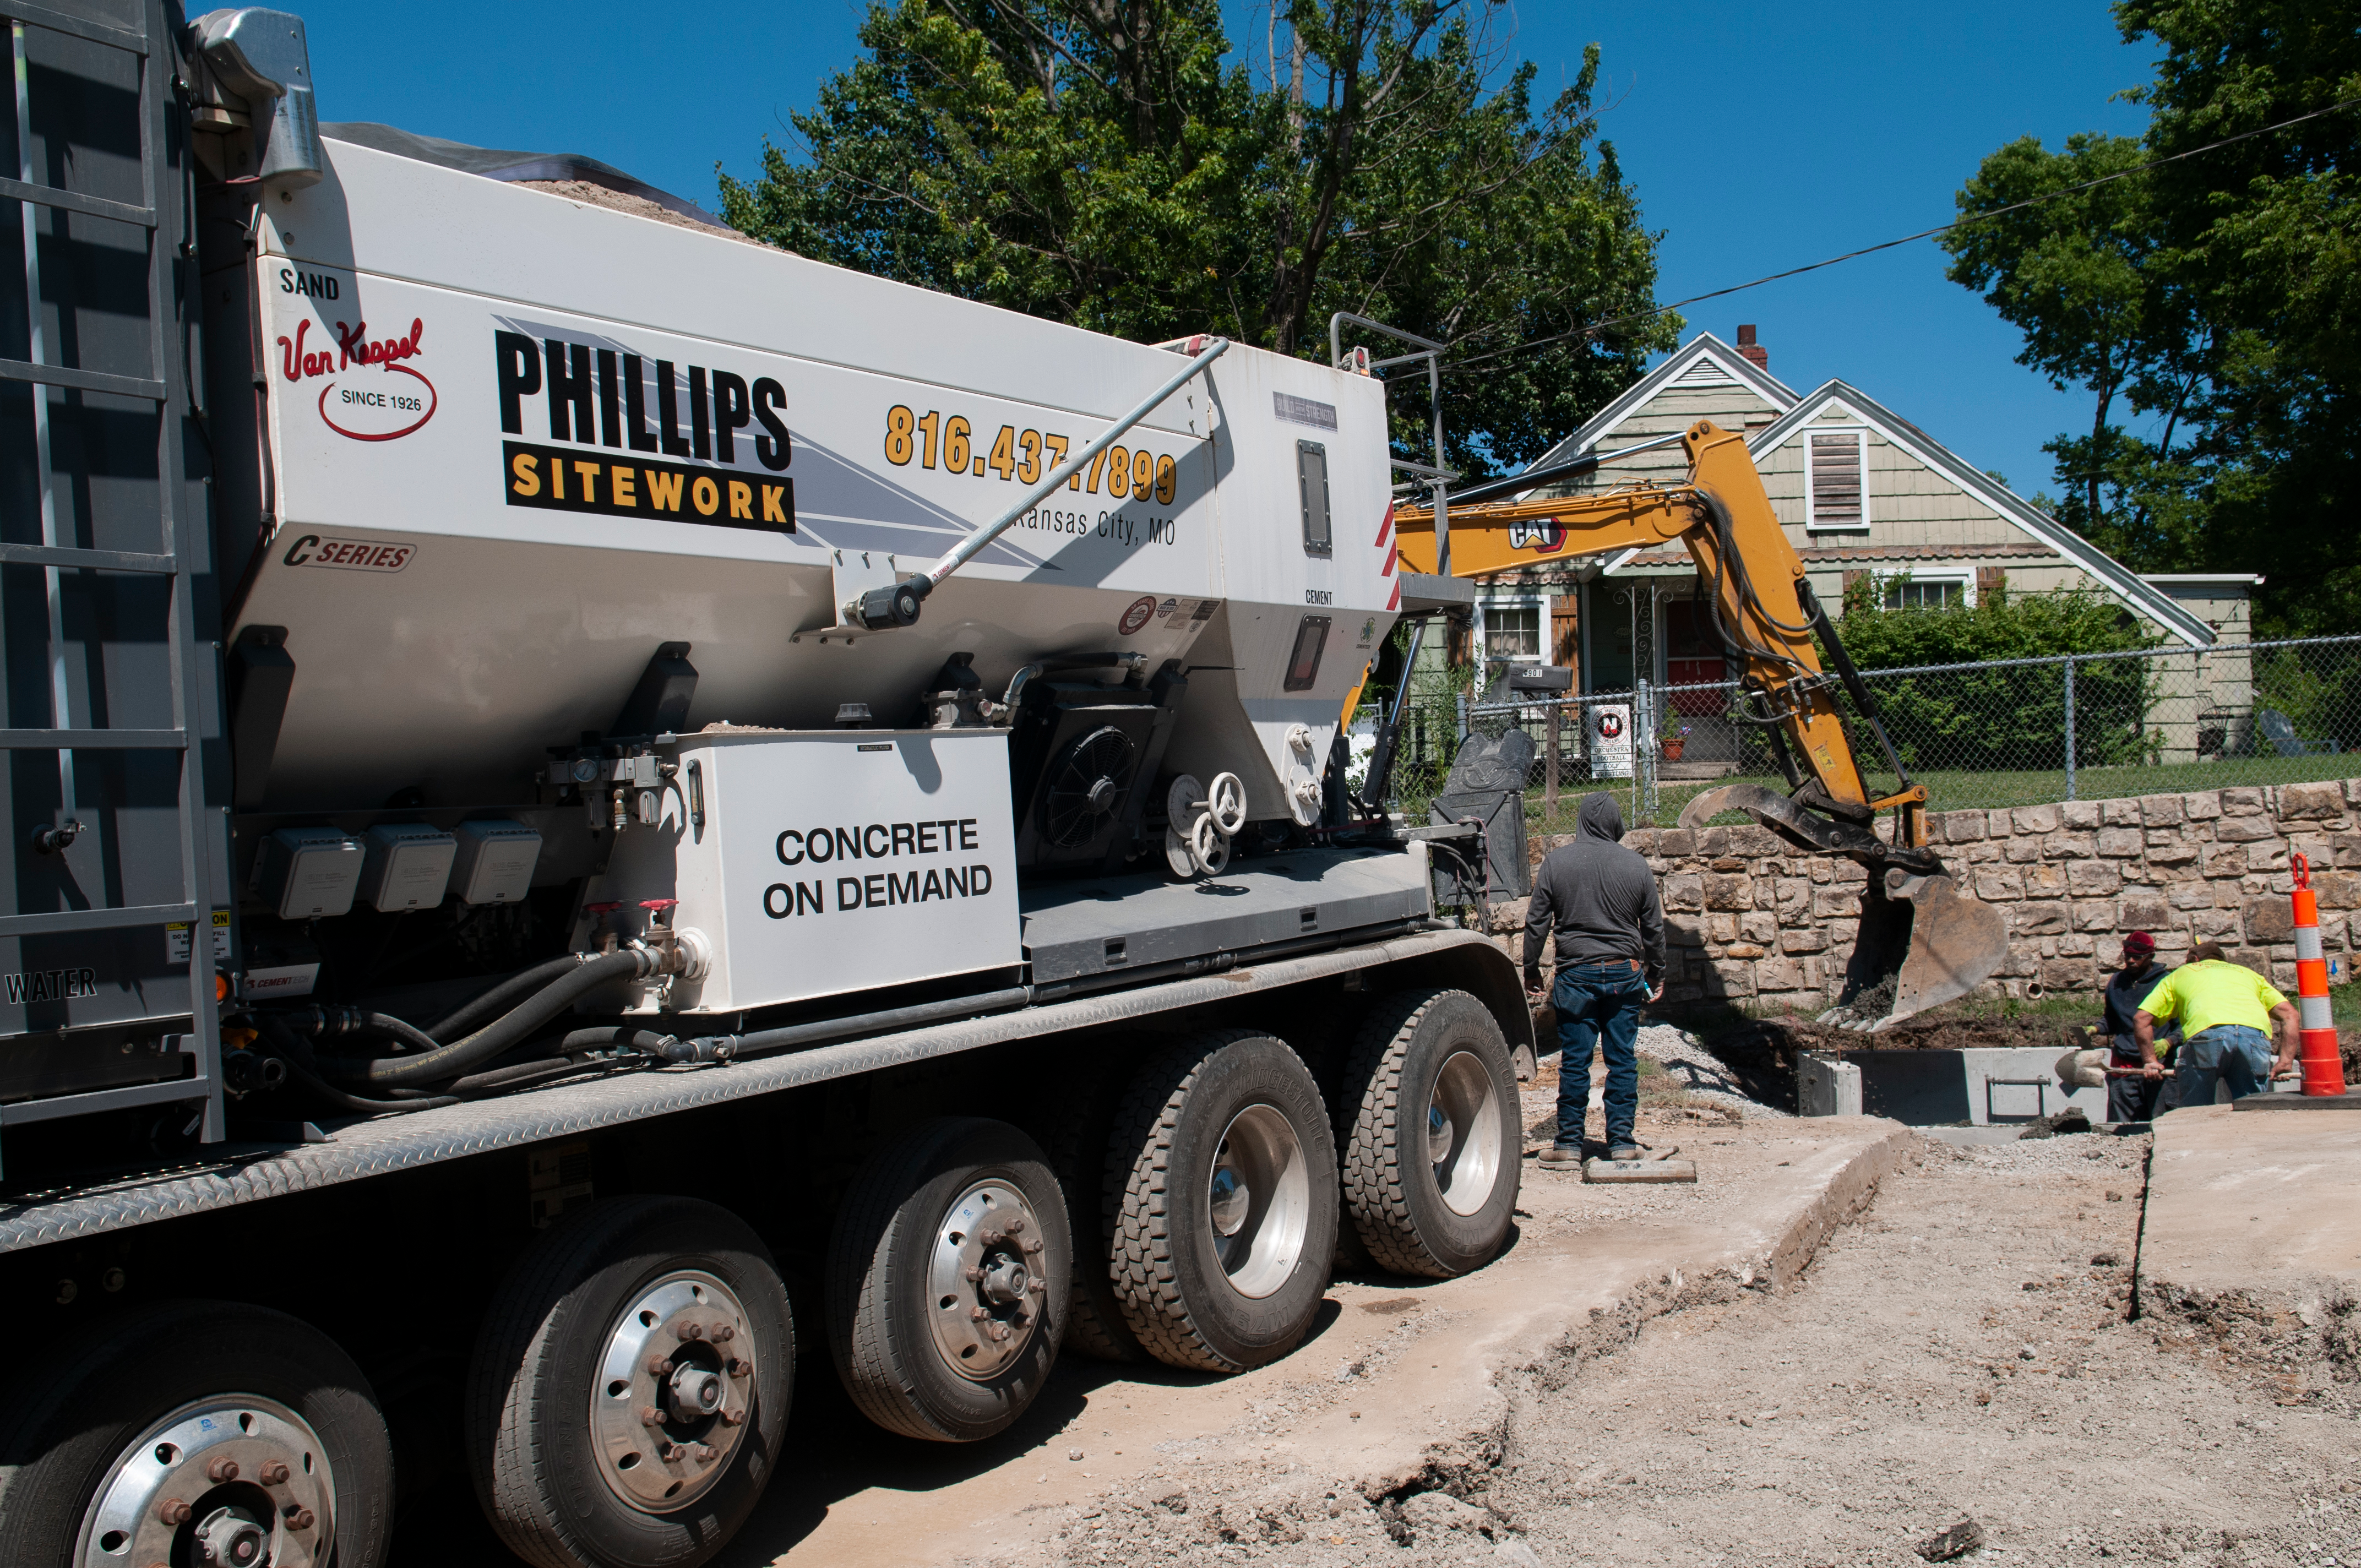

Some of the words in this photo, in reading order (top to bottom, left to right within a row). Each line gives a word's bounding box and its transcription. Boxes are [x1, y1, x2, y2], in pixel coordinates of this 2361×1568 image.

[280, 269, 339, 300] SAND
[278, 319, 337, 382] Van
[336, 317, 423, 372] Keppel
[341, 390, 386, 406] SINCE
[390, 396, 422, 412] 1926
[495, 329, 792, 471] PHILLIPS
[1277, 398, 1294, 413] BUILD
[1305, 405, 1335, 423] STRENGTH
[513, 454, 787, 523] SITEWORK
[1097, 510, 1138, 546] City,
[1149, 518, 1175, 546] MO
[1509, 518, 1552, 548] CAT
[283, 535, 320, 566] C
[316, 543, 409, 568] SERIES
[1305, 589, 1332, 606] CEMENT
[1603, 718, 1617, 734] N
[776, 818, 979, 866] CONCRETE
[763, 880, 824, 919] ON
[837, 864, 992, 911] DEMAND
[5, 967, 97, 1004] WATER
[258, 976, 310, 988] CEMENTECH
[395, 1063, 417, 1074] (51mm)
[427, 1054, 439, 1063] 225
[1449, 1019, 1519, 1116] BRIDGESTONE
[1227, 1068, 1328, 1152] BRIDGESTONE
[1217, 1292, 1290, 1335] M799
[559, 1353, 587, 1502] IRONMAN
